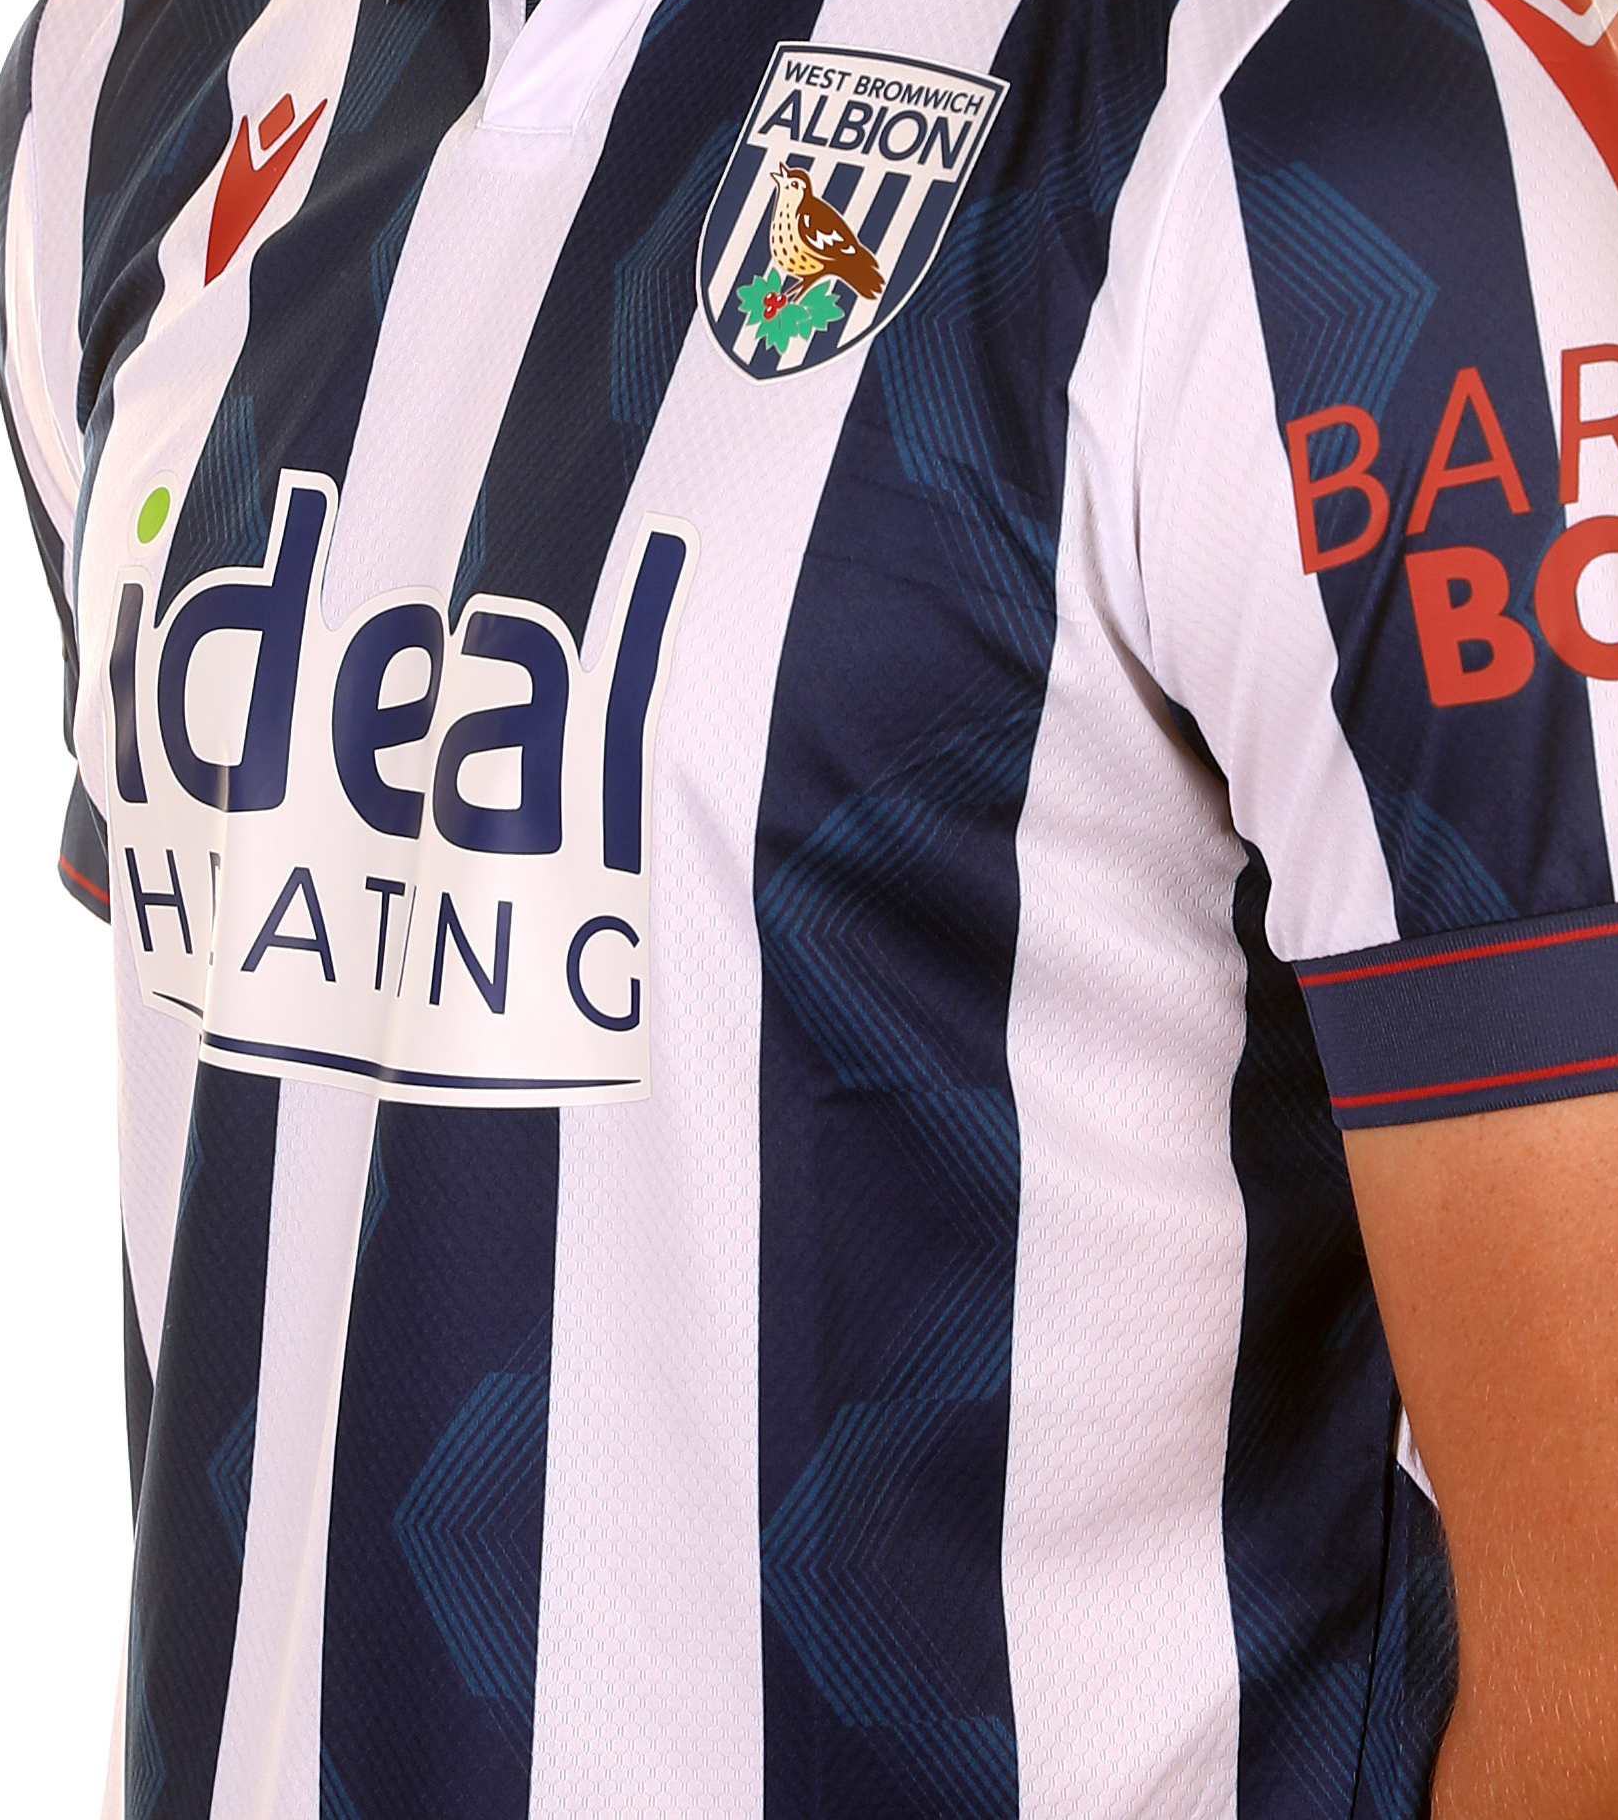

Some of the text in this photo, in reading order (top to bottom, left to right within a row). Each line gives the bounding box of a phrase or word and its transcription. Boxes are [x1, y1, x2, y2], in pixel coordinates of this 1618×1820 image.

[758, 90, 973, 169] ALBION
[784, 61, 984, 115] WEST BROMWICH
[109, 486, 687, 874] ideal
[124, 847, 642, 1033] HATNG
